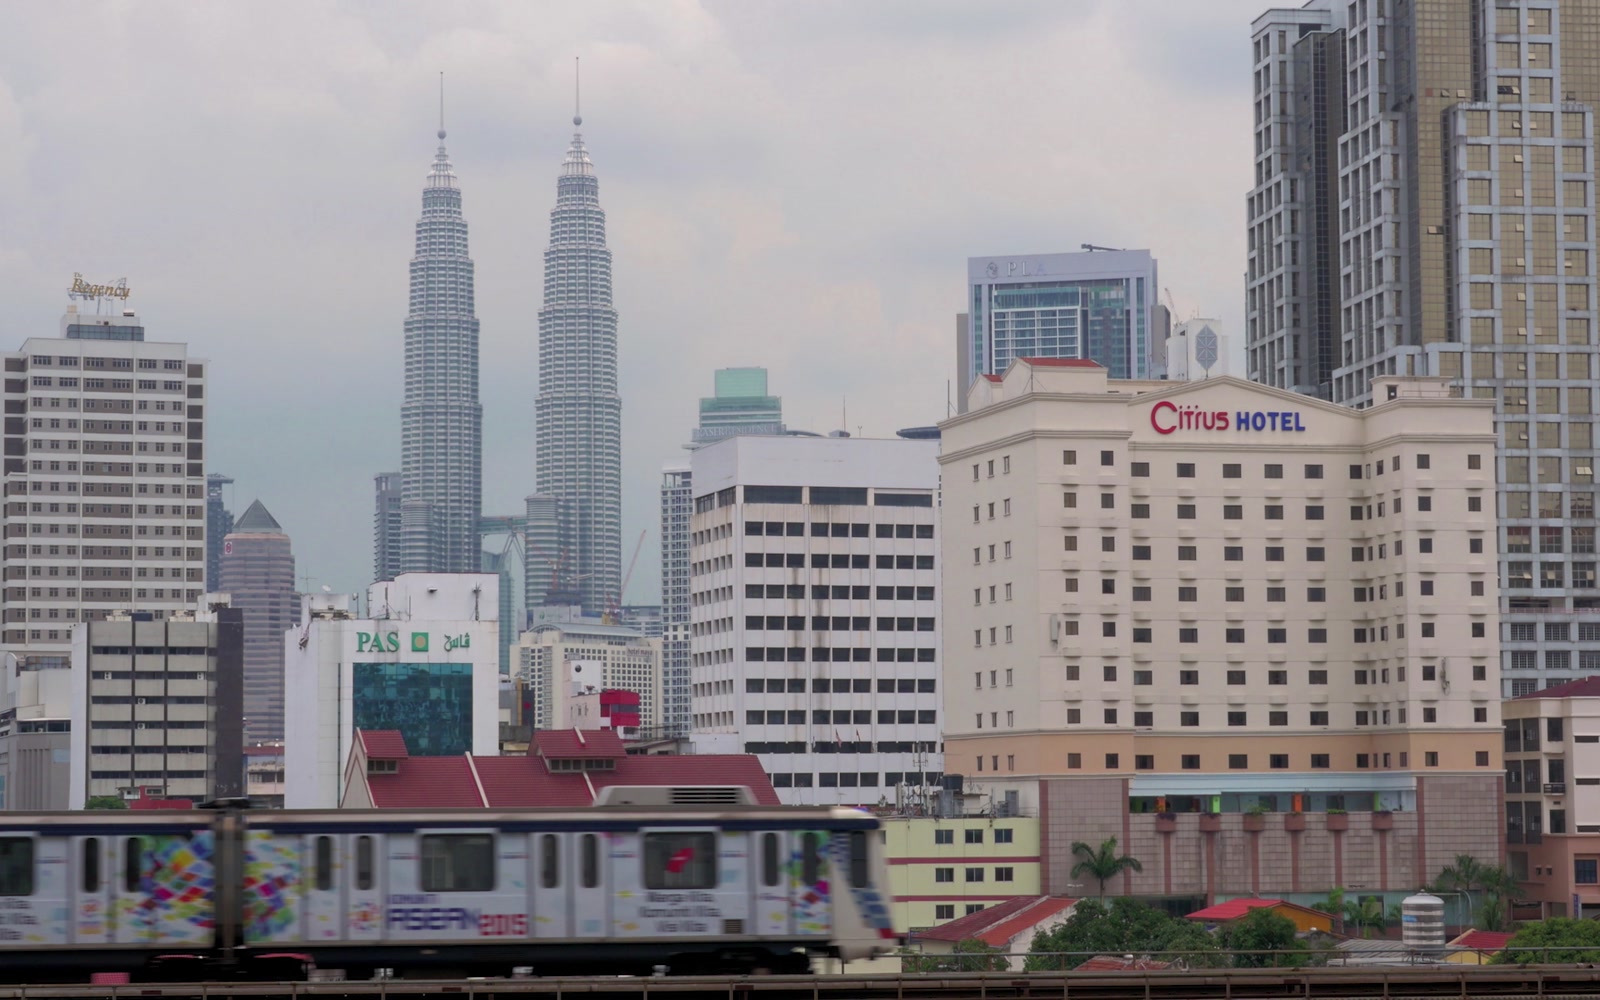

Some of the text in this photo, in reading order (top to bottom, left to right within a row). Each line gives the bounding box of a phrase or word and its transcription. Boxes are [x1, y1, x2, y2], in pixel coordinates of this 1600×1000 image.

[71, 278, 130, 300] Regency
[1150, 400, 1306, 435] Citrus HOTEL
[356, 631, 400, 653] PAS
[387, 907, 528, 936] ASEAN 2015
